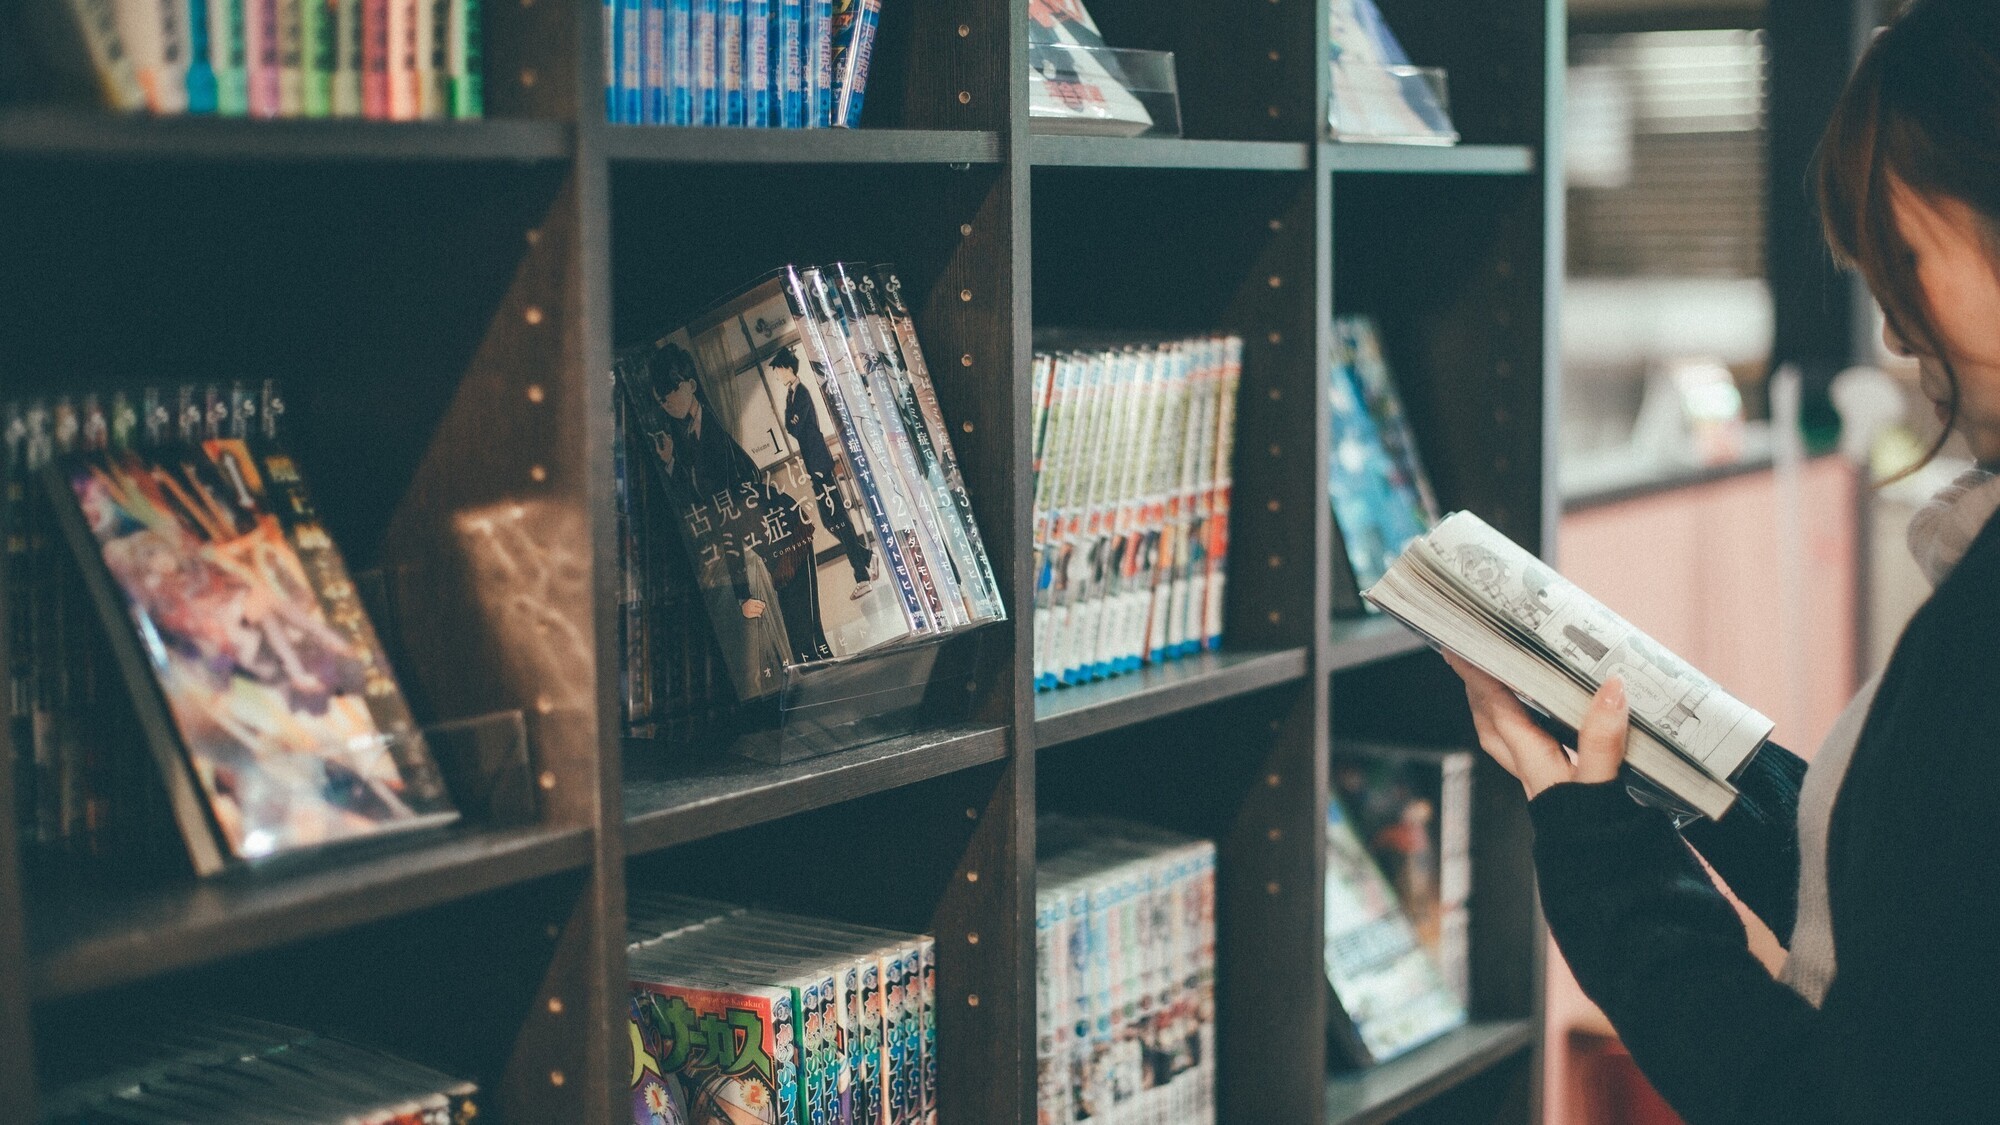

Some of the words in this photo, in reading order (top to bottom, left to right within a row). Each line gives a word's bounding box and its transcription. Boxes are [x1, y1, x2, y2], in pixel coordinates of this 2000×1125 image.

[766, 427, 783, 455] 1
[684, 455, 824, 538] 古見さんは、
[918, 491, 931, 512] 4
[937, 486, 951, 507] 5
[956, 486, 970, 508] 3
[701, 483, 852, 567] コミュ症です。
[870, 494, 884, 517] 1
[880, 522, 917, 605] オダトモヒト
[892, 495, 907, 517] 2
[903, 524, 938, 605] オダトモヒト
[731, 998, 765, 1009] Karakuri
[652, 1089, 662, 1108] 1
[749, 1085, 761, 1104] 2
